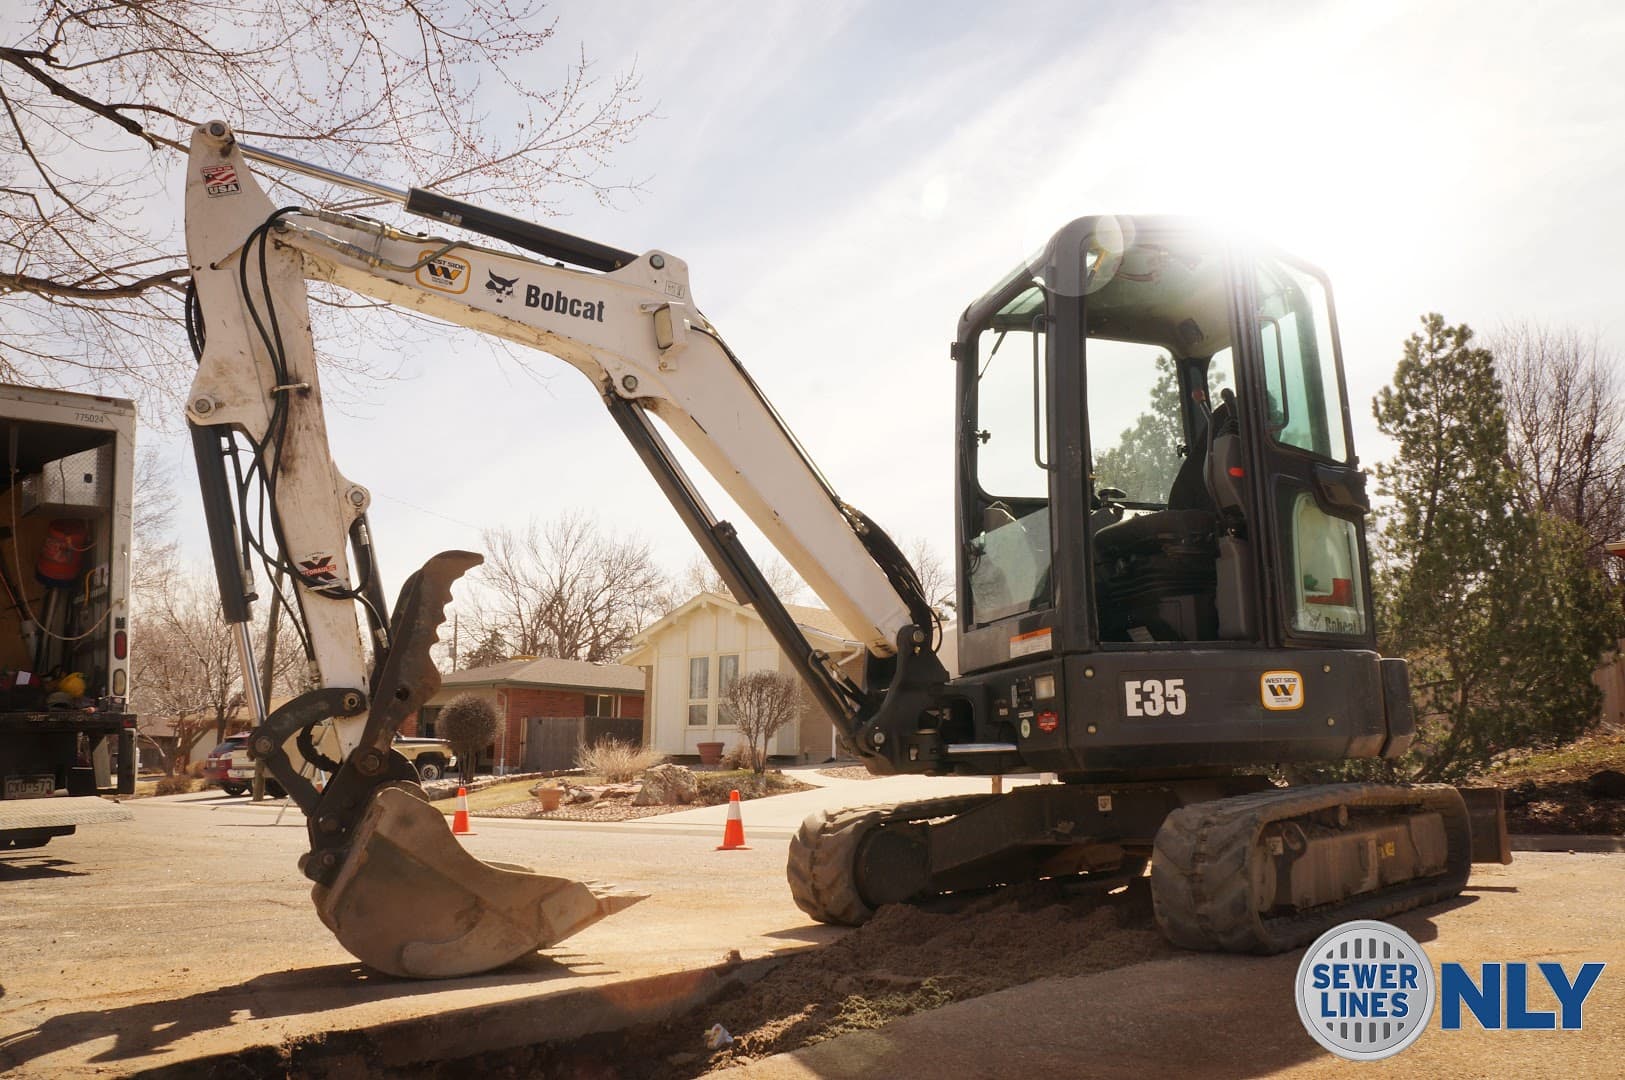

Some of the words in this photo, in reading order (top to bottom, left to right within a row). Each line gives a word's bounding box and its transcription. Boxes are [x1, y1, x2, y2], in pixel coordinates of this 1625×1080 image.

[208, 184, 239, 194] USA
[525, 284, 605, 323] Bobcat
[74, 412, 104, 423] 775024
[1125, 679, 1186, 716] E35
